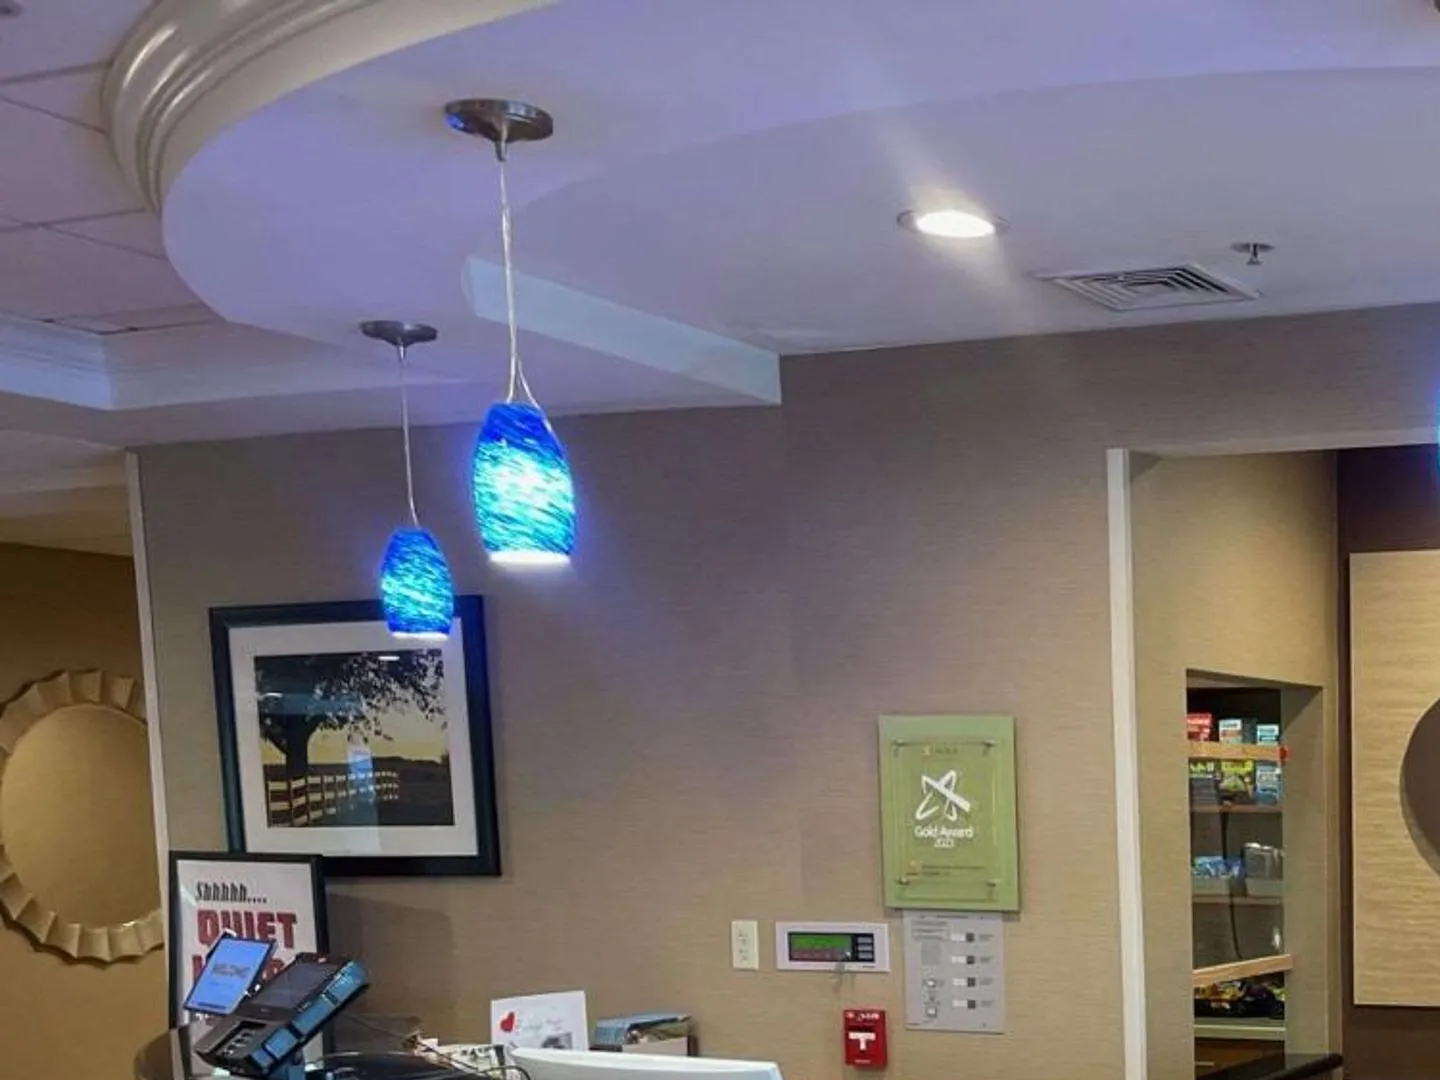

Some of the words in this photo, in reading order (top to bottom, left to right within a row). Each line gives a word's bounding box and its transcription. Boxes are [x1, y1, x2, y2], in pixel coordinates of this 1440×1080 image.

[915, 825, 938, 838] Gold
[940, 825, 974, 838] Award
[197, 909, 298, 949] QUIET
